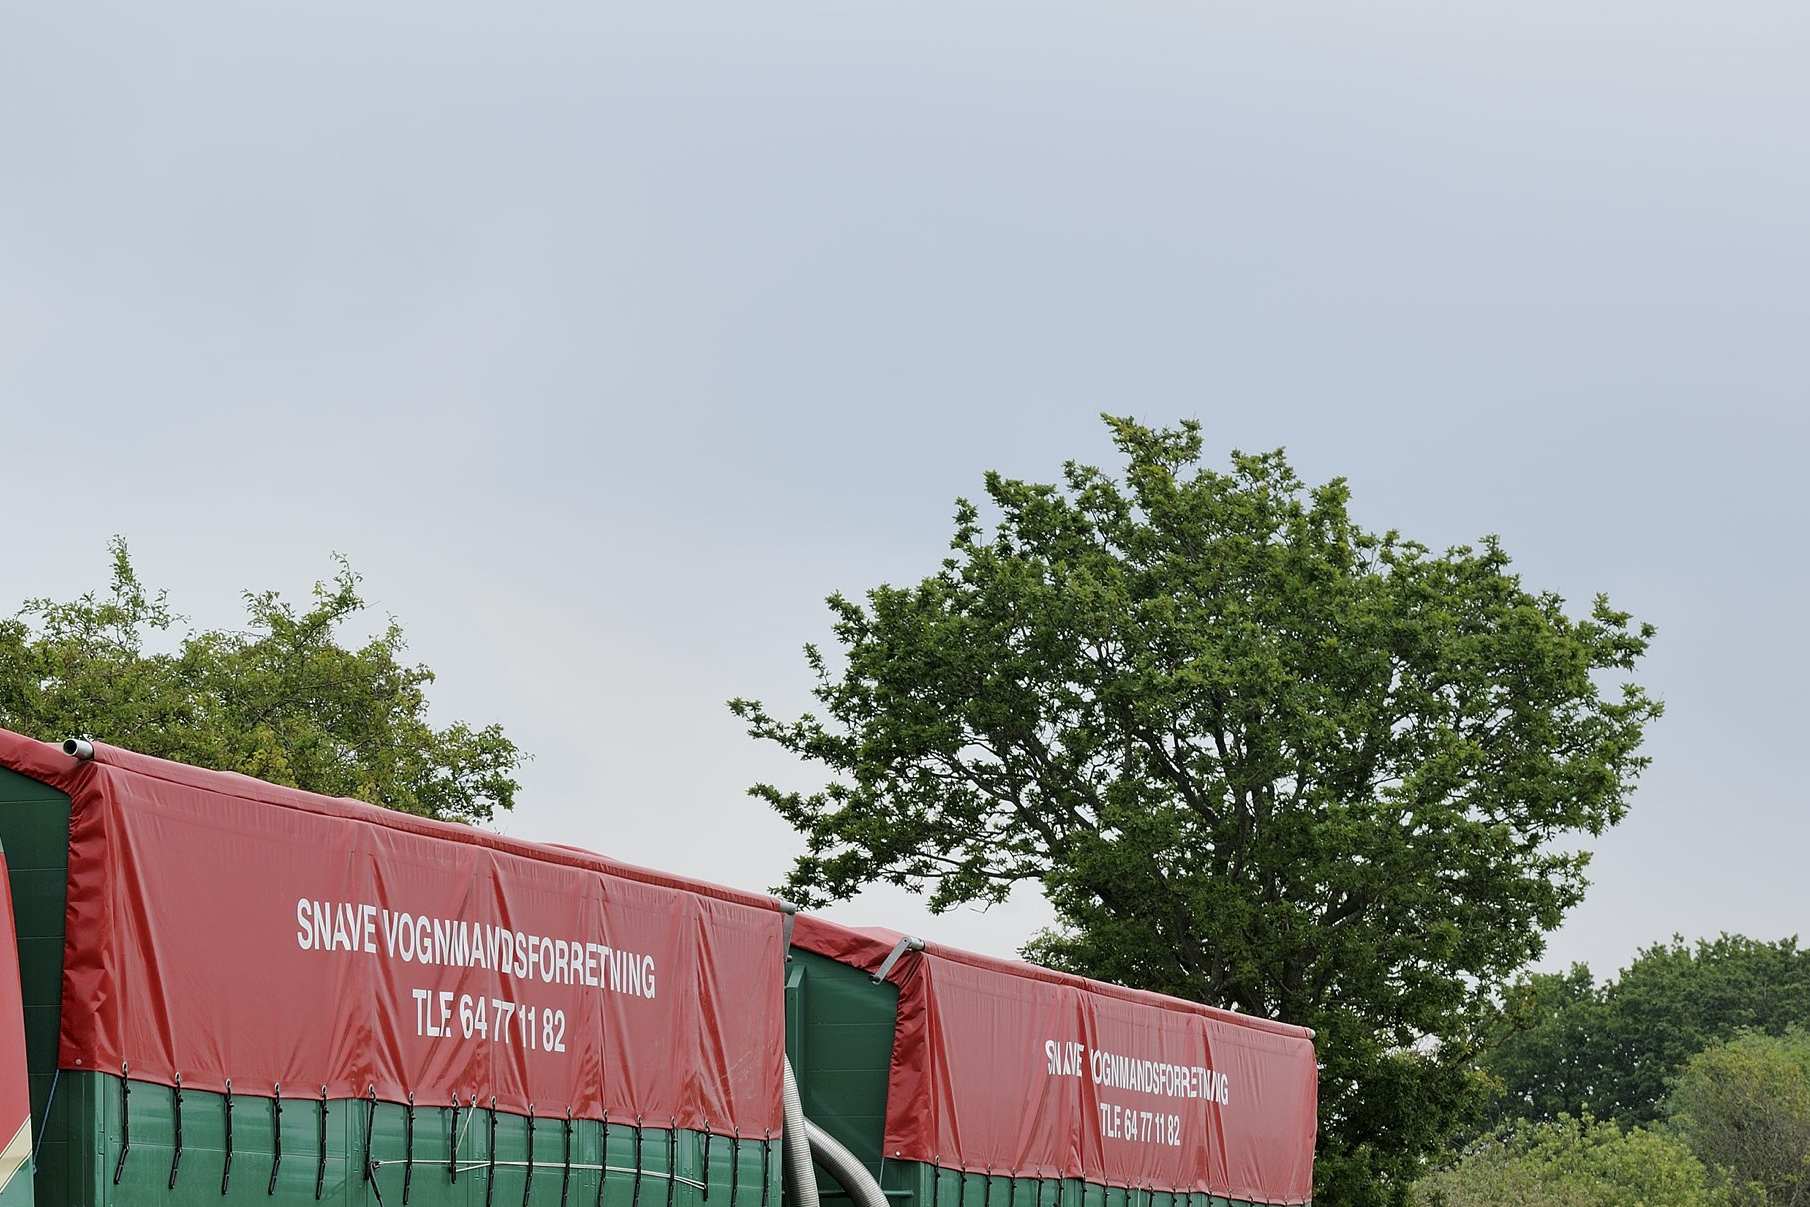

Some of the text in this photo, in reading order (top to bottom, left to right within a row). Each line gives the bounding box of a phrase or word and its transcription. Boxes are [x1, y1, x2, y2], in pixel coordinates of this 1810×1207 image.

[296, 898, 656, 999] SNAVE VOGNMANDSFORRETNING
[459, 993, 488, 1040] 64
[492, 998, 516, 1044] 77
[519, 1004, 536, 1050] 11
[542, 1007, 566, 1053] 82
[1044, 1039, 1085, 1077] SNAVE
[1124, 1108, 1138, 1141] 64
[1140, 1111, 1153, 1143] 77
[1155, 1112, 1165, 1145] 11
[1167, 1114, 1180, 1146] 82
